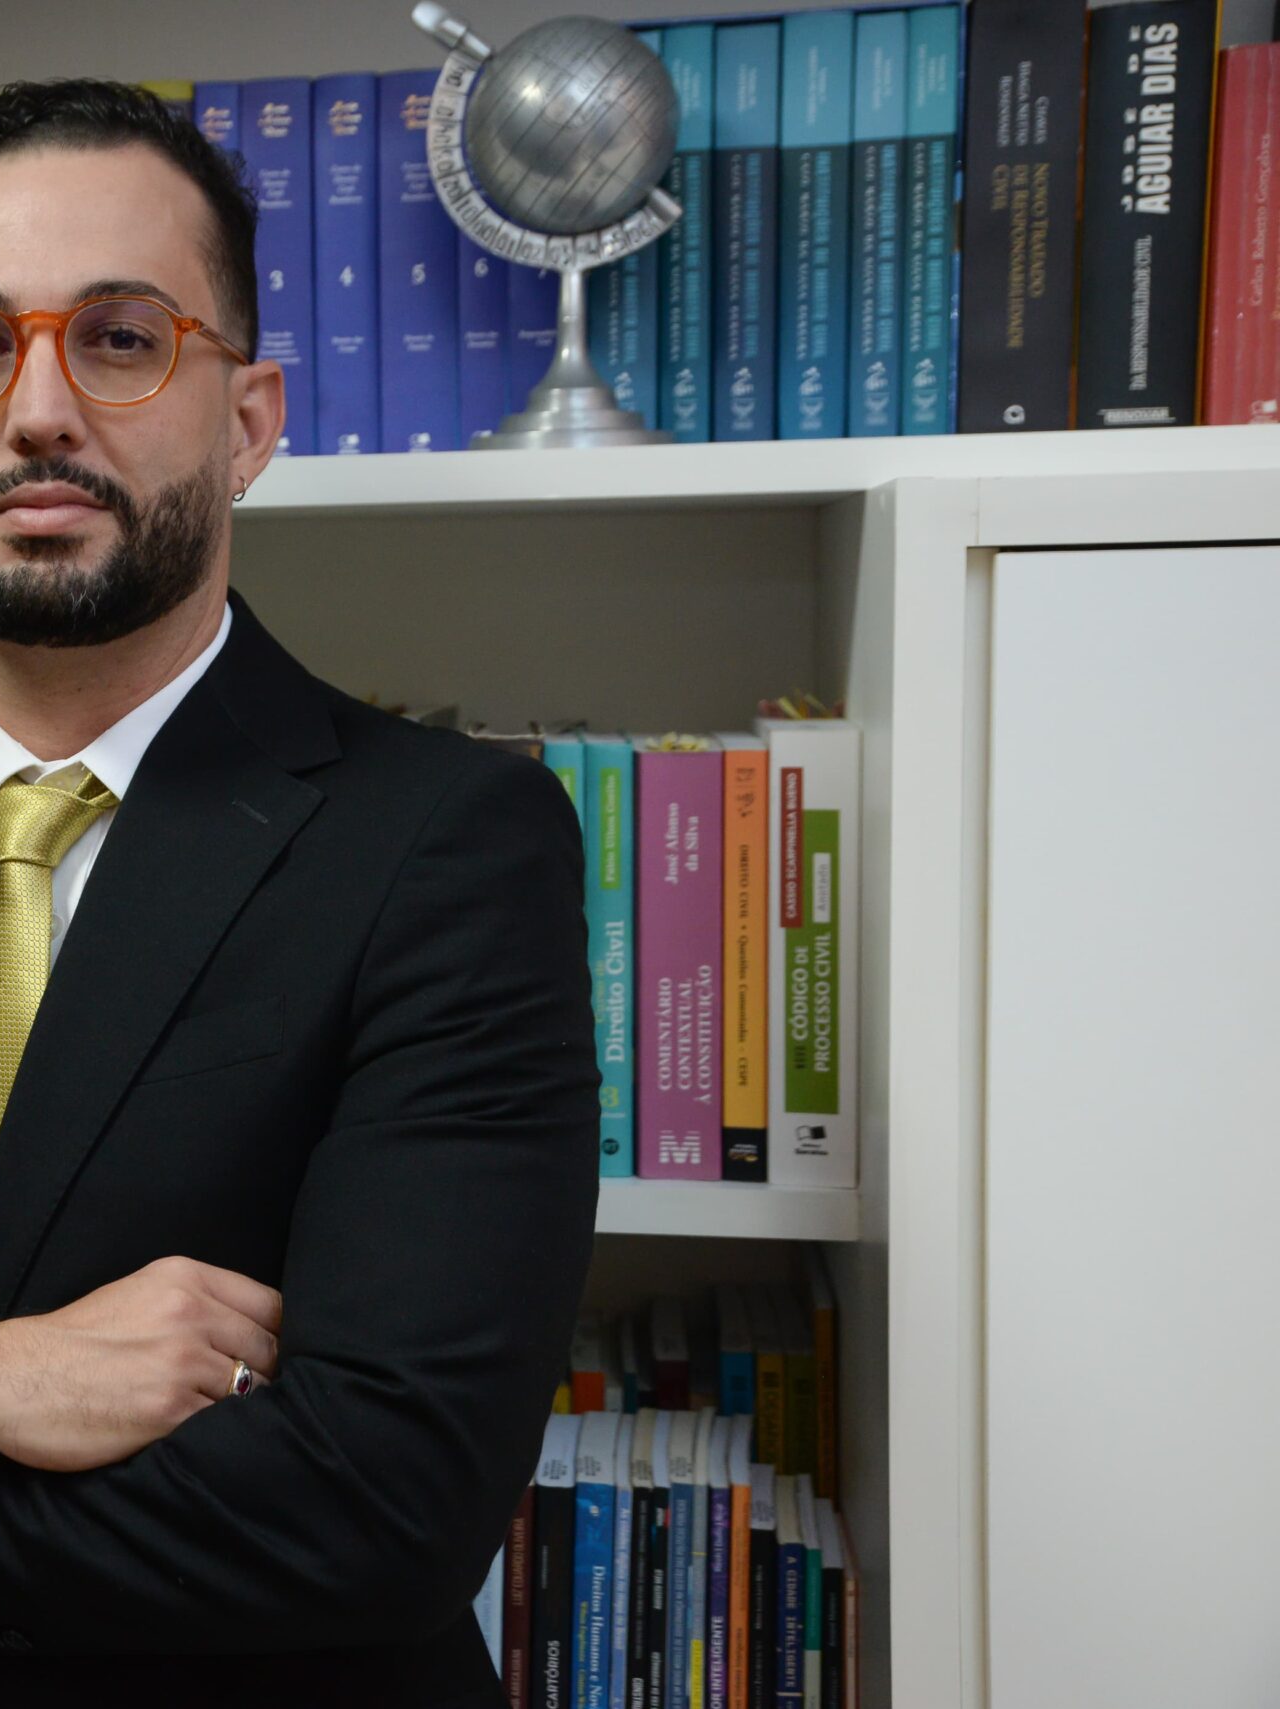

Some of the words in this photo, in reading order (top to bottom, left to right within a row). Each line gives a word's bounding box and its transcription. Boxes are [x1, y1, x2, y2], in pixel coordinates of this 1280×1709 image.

[1141, 21, 1180, 97] DIAS
[1135, 102, 1176, 215] AGUIAR
[1254, 133, 1272, 203] Gonçalves
[990, 164, 1011, 211] CIVIL
[1032, 163, 1051, 218] NOVO
[1134, 234, 1152, 264] CIVIL
[1252, 206, 1267, 260] Roberto
[269, 269, 284, 291] 3
[339, 264, 355, 287] 4
[474, 257, 489, 278] 6
[1028, 218, 1050, 299] TRATADO
[1250, 264, 1264, 306] Carlos
[1130, 265, 1150, 374] RESPONSABILIDADE
[785, 772, 797, 811] BUENO
[664, 802, 680, 851] Afonso
[684, 815, 699, 850] Silva
[785, 811, 797, 880] SCARPINELLA
[663, 853, 679, 884] José
[684, 854, 699, 872] da
[738, 844, 750, 888] DIREITO
[738, 892, 750, 920] CIVIL
[785, 880, 797, 919] CASSIO
[604, 920, 625, 976] Civil
[794, 946, 809, 965] DE
[814, 932, 831, 978] CIVIL
[604, 982, 625, 1063] Direito
[694, 964, 715, 1091] CONSTITUIÇÃO
[788, 968, 809, 1041] CÓDIGO
[813, 981, 831, 1073] PROCESSO
[654, 976, 673, 1092] COMENTÁRIO
[677, 977, 693, 1091] CONTEXTUAL
[693, 1093, 713, 1105] À
[786, 1556, 798, 1565] A
[592, 1565, 607, 1613] Direitos
[785, 1570, 798, 1610] CIDADE
[590, 1616, 605, 1673] Humanos
[710, 1616, 724, 1691] INTELIGENTE
[544, 1640, 561, 1709] CARTÓRIOS
